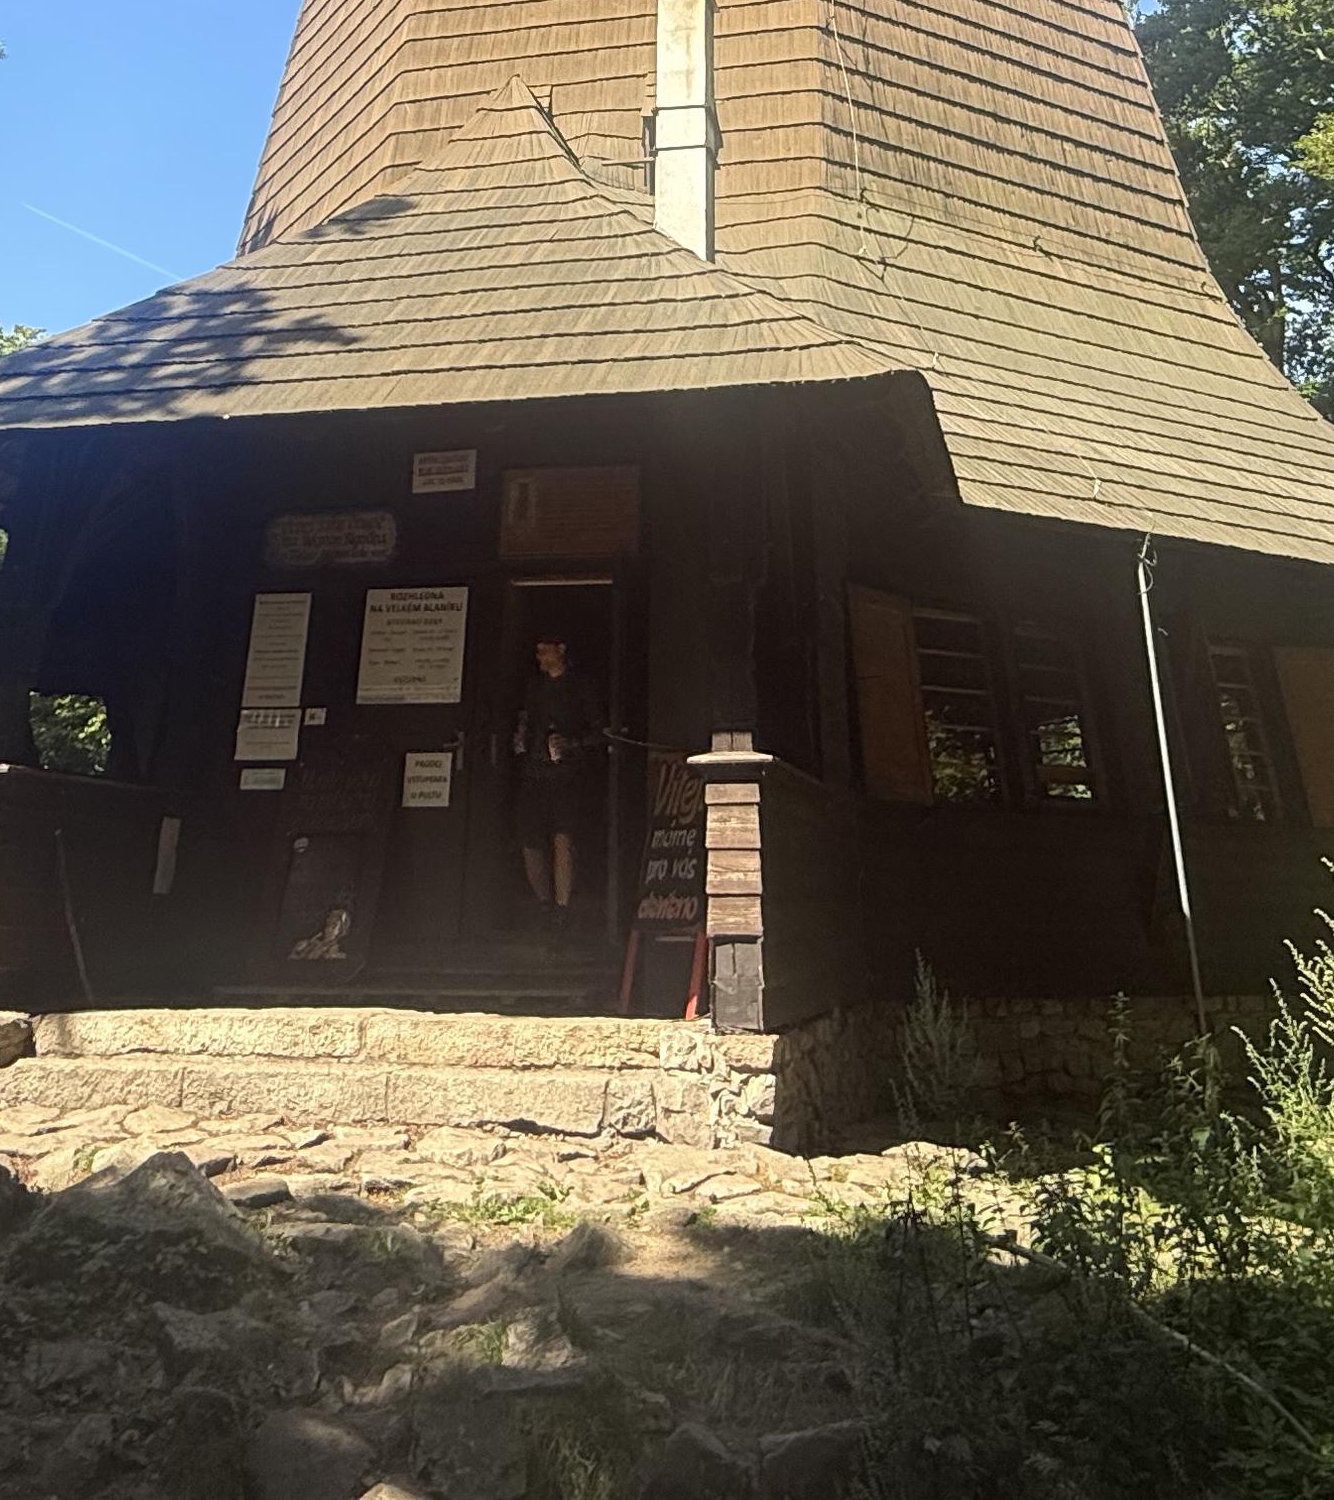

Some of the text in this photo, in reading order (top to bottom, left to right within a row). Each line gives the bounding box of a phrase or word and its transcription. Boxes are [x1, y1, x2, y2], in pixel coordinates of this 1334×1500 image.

[390, 591, 444, 601] ROZHLEDNA
[370, 604, 383, 613] NA
[650, 818, 698, 848] máme
[645, 848, 698, 885] pro vás
